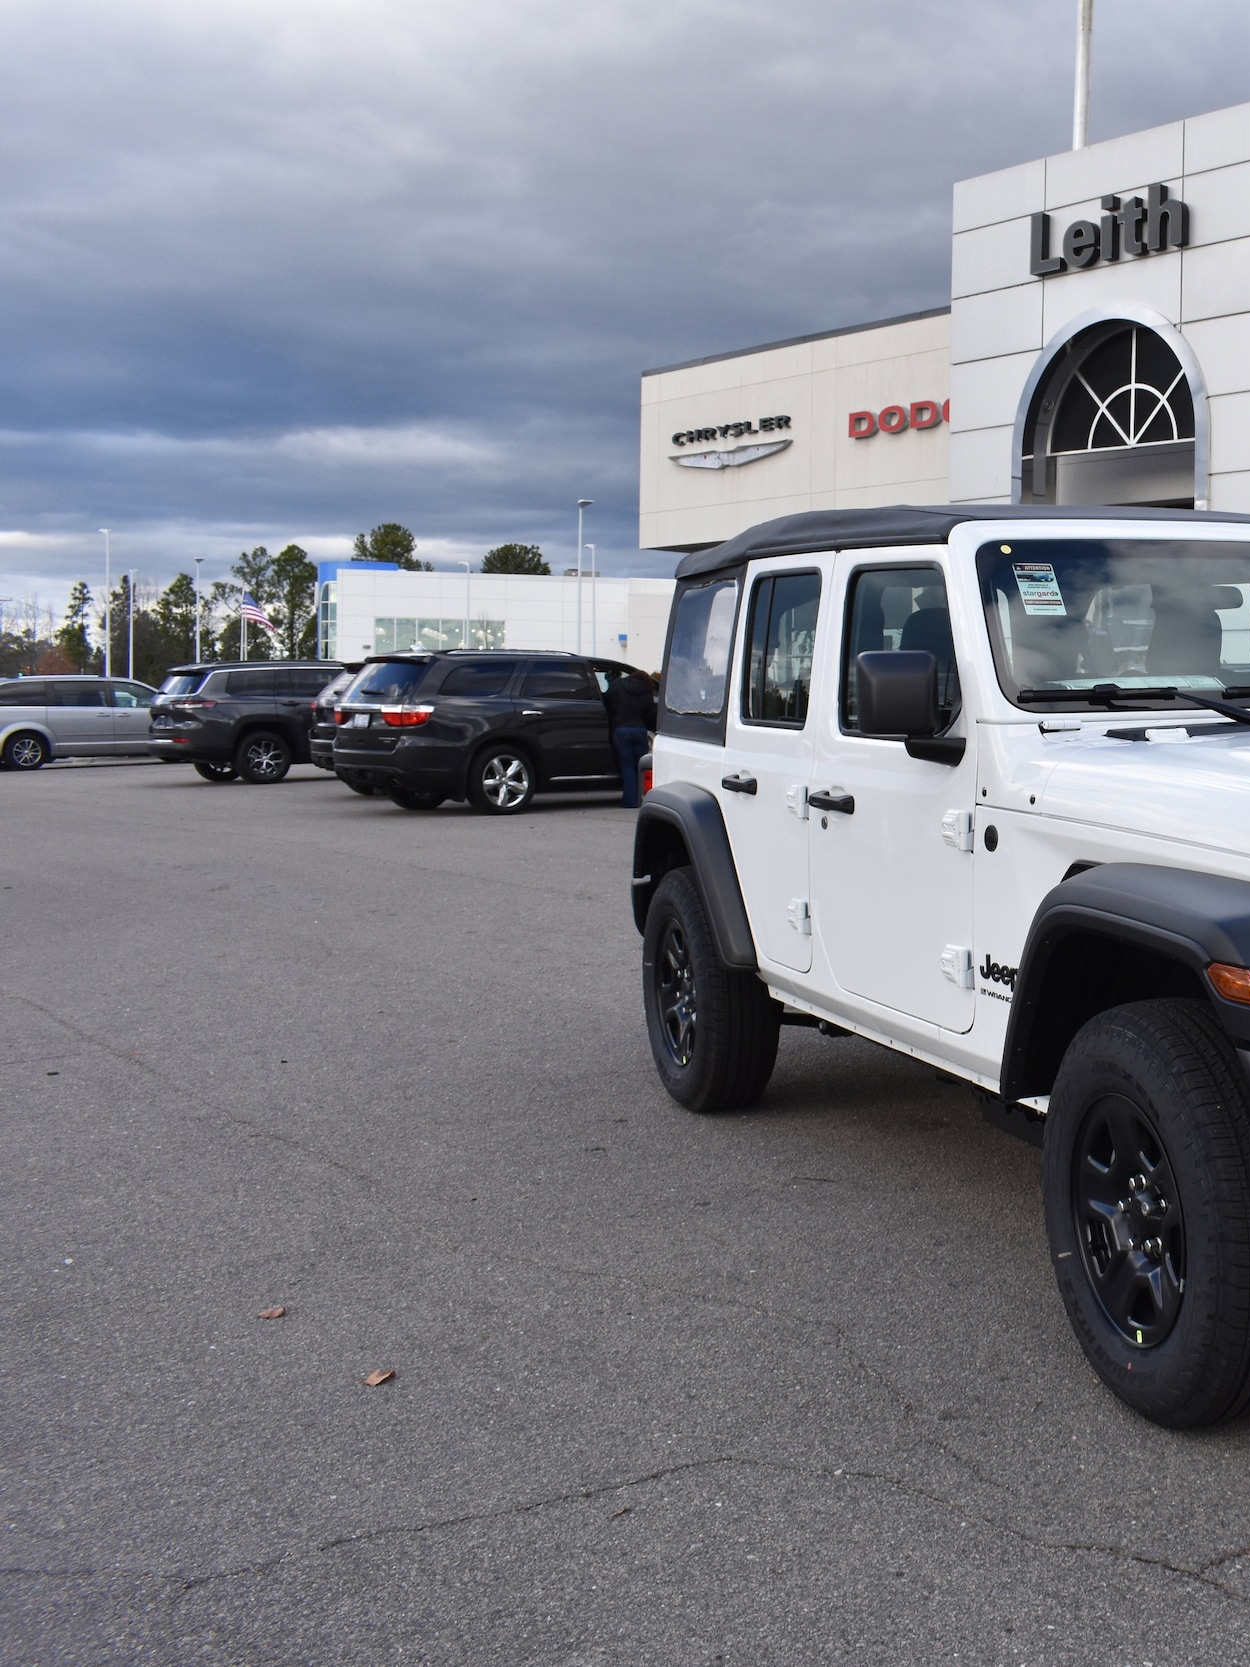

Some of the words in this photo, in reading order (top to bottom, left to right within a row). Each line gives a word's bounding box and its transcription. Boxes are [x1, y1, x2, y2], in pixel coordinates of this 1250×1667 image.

[1030, 183, 1190, 277] Leith
[671, 414, 792, 446] CHRYSLER
[848, 398, 950, 440] DOD
